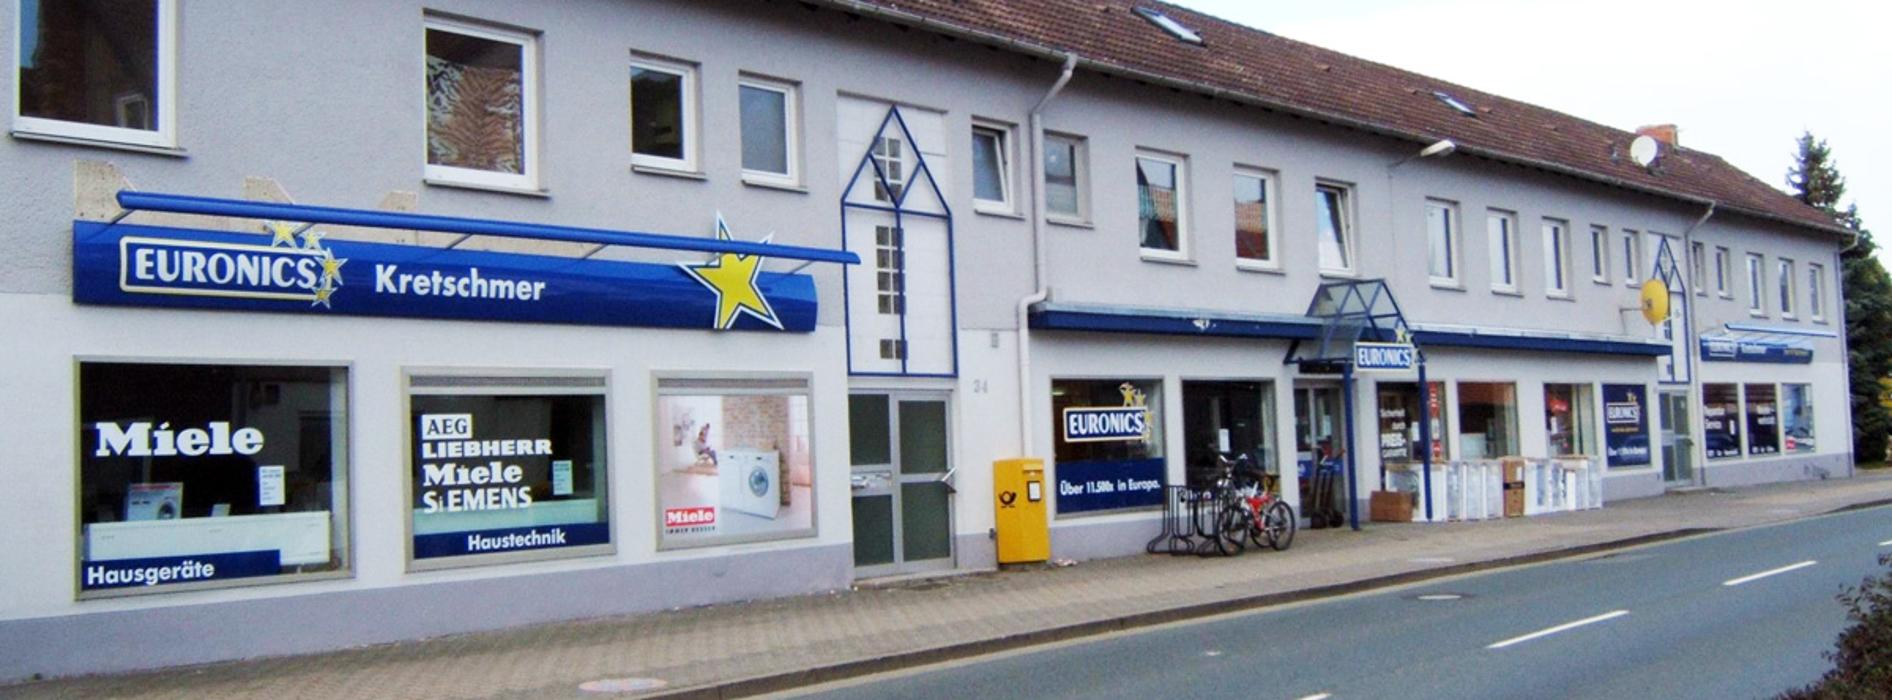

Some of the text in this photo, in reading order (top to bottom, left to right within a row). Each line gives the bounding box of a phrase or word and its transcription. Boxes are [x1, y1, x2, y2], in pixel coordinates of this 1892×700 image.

[135, 248, 546, 300] EURONICS Kretschmer
[1358, 348, 1410, 366] EURONICS
[426, 418, 467, 435] AEG
[1069, 412, 1144, 435] EURONICS
[96, 421, 264, 457] Miele
[422, 439, 552, 459] LIEBHERR
[423, 462, 523, 486] Miele
[1060, 480, 1084, 495] Über
[1117, 479, 1127, 491] in
[1128, 478, 1160, 492] Europa.
[667, 510, 714, 523] Miele
[468, 528, 566, 551] Haustechnik
[87, 560, 215, 586] Hausgeräte
